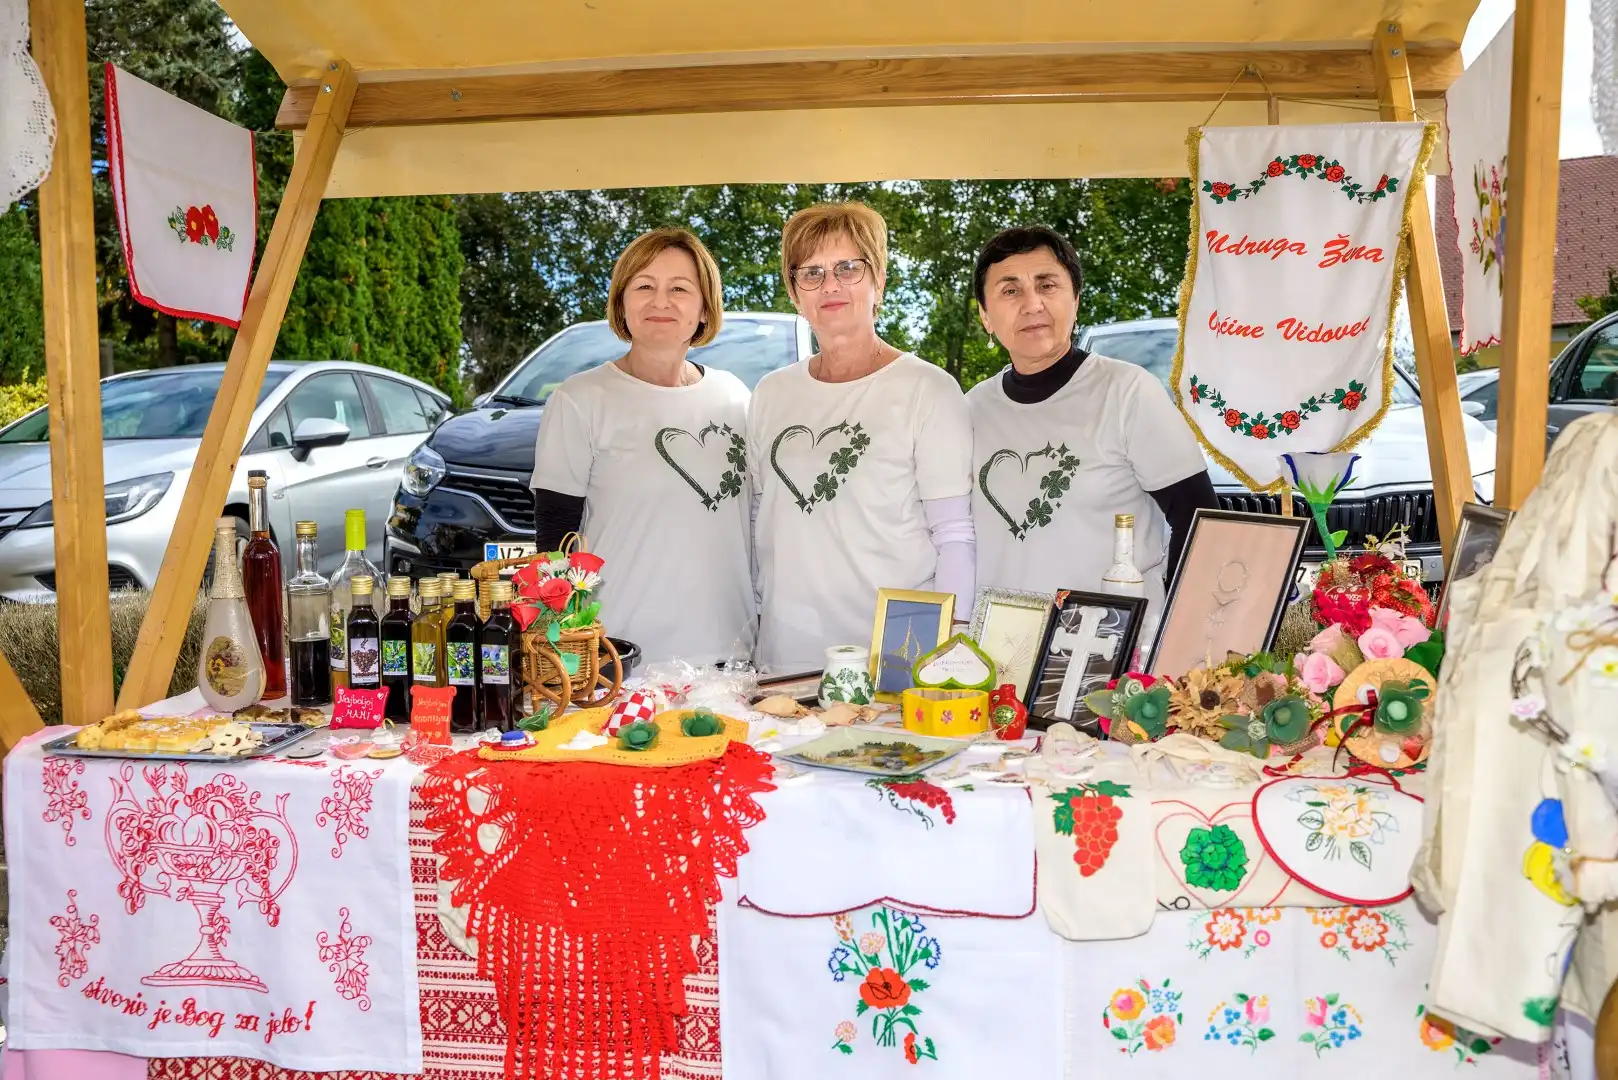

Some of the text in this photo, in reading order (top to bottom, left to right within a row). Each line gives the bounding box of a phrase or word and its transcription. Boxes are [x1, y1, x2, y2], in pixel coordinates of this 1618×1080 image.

[1206, 230, 1385, 269] Udruga Žena
[80, 976, 317, 1044] stvorio je Bog za jelo!
